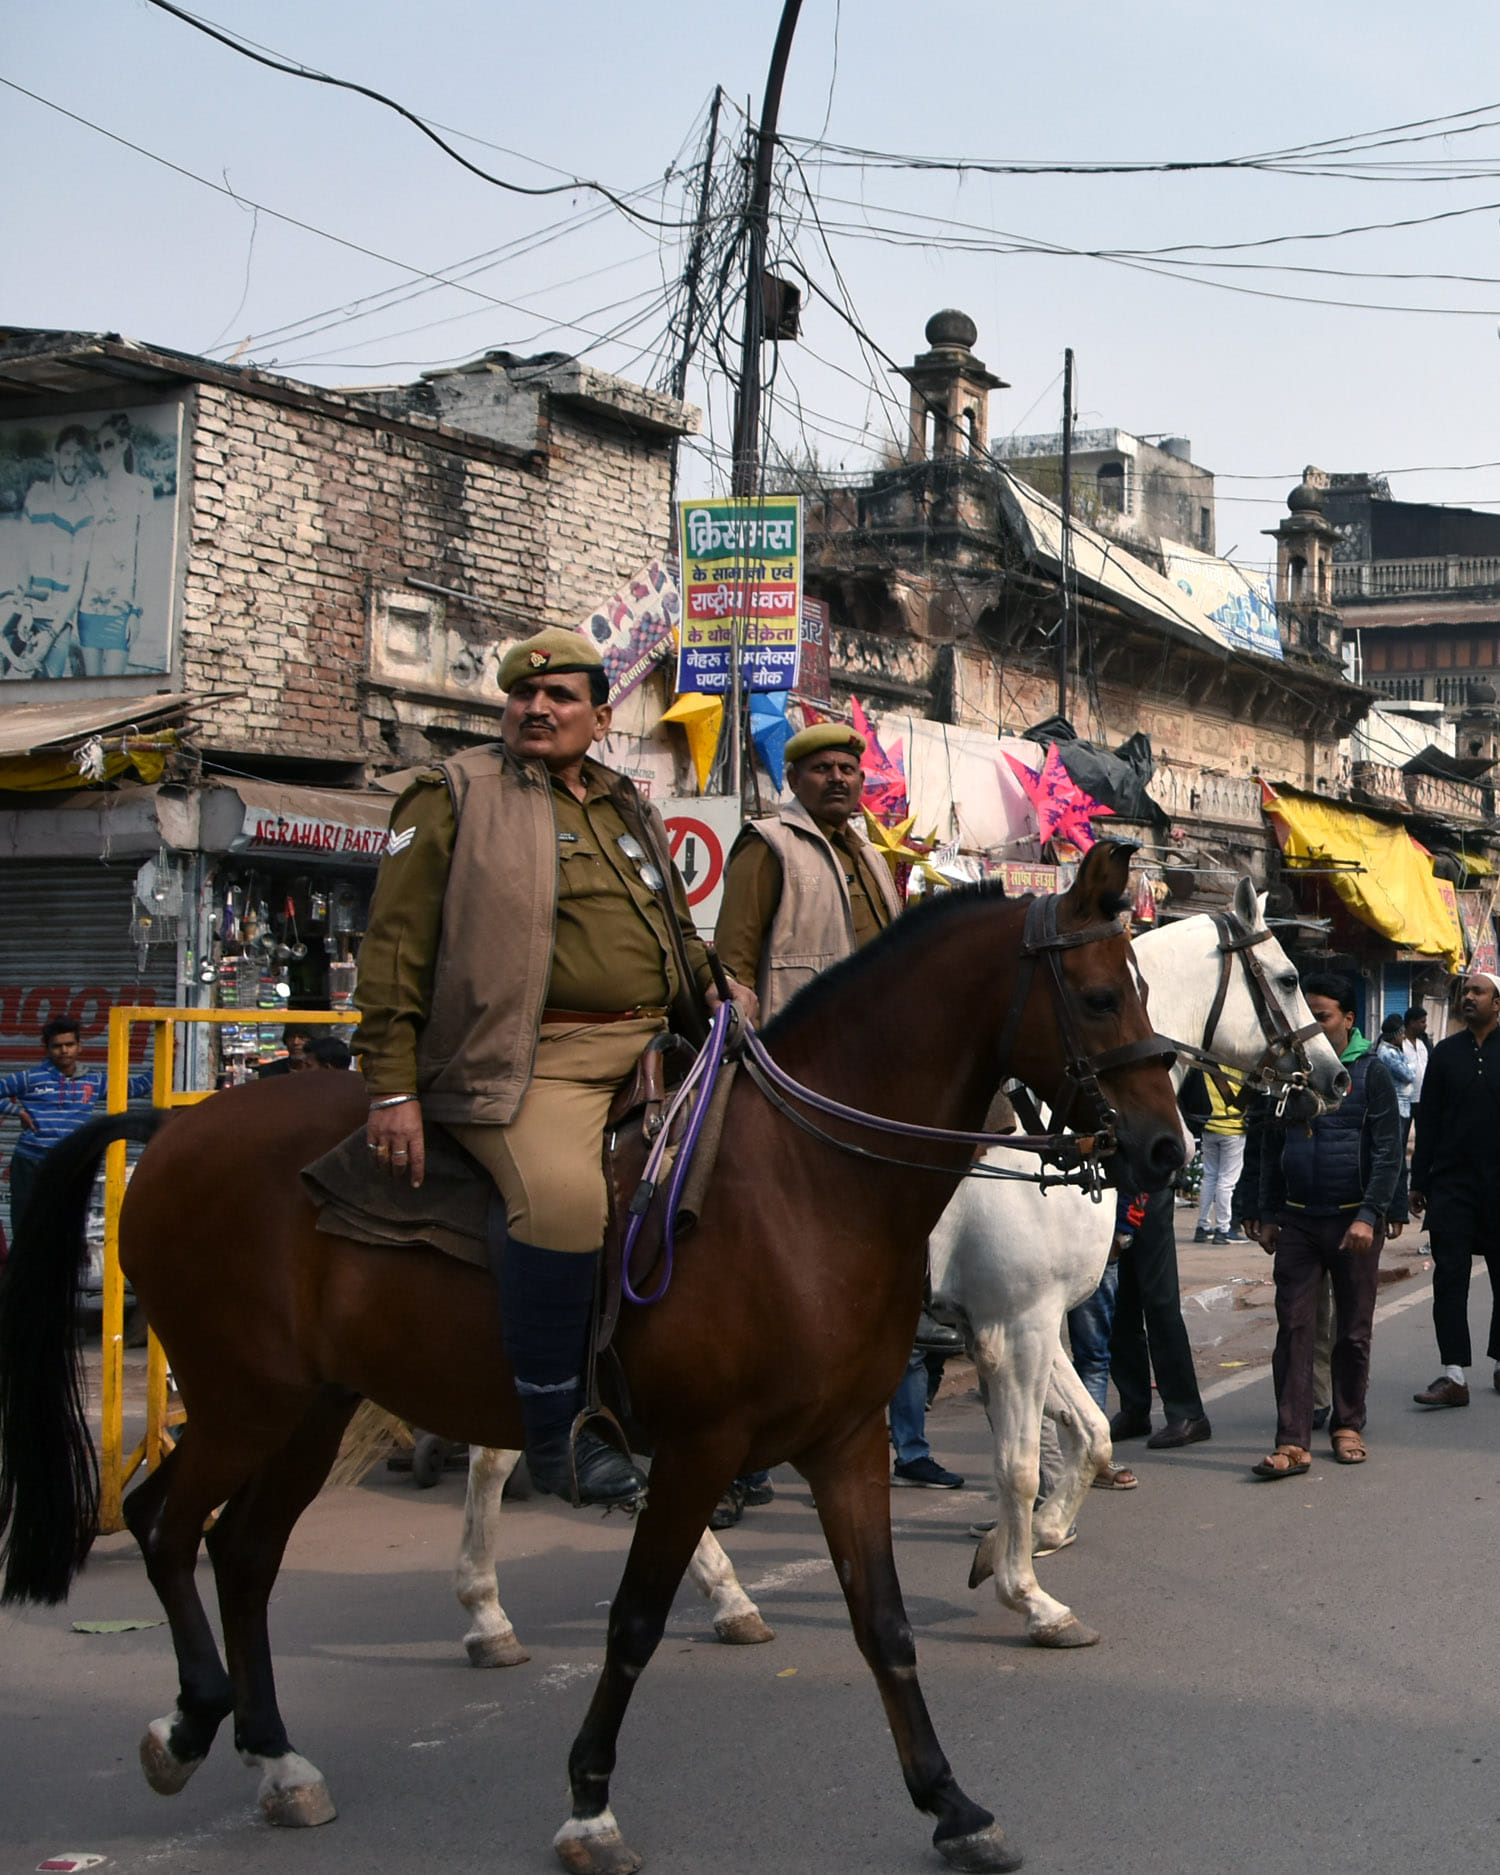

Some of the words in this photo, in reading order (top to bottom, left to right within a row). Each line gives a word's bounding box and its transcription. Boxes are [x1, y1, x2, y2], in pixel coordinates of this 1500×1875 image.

[692, 564, 708, 582] के
[771, 562, 794, 580] एवं
[691, 584, 743, 615] राष्ट्रीय
[687, 625, 704, 643] के
[752, 666, 784, 686] चौक
[256, 820, 342, 852] AGRAHARI
